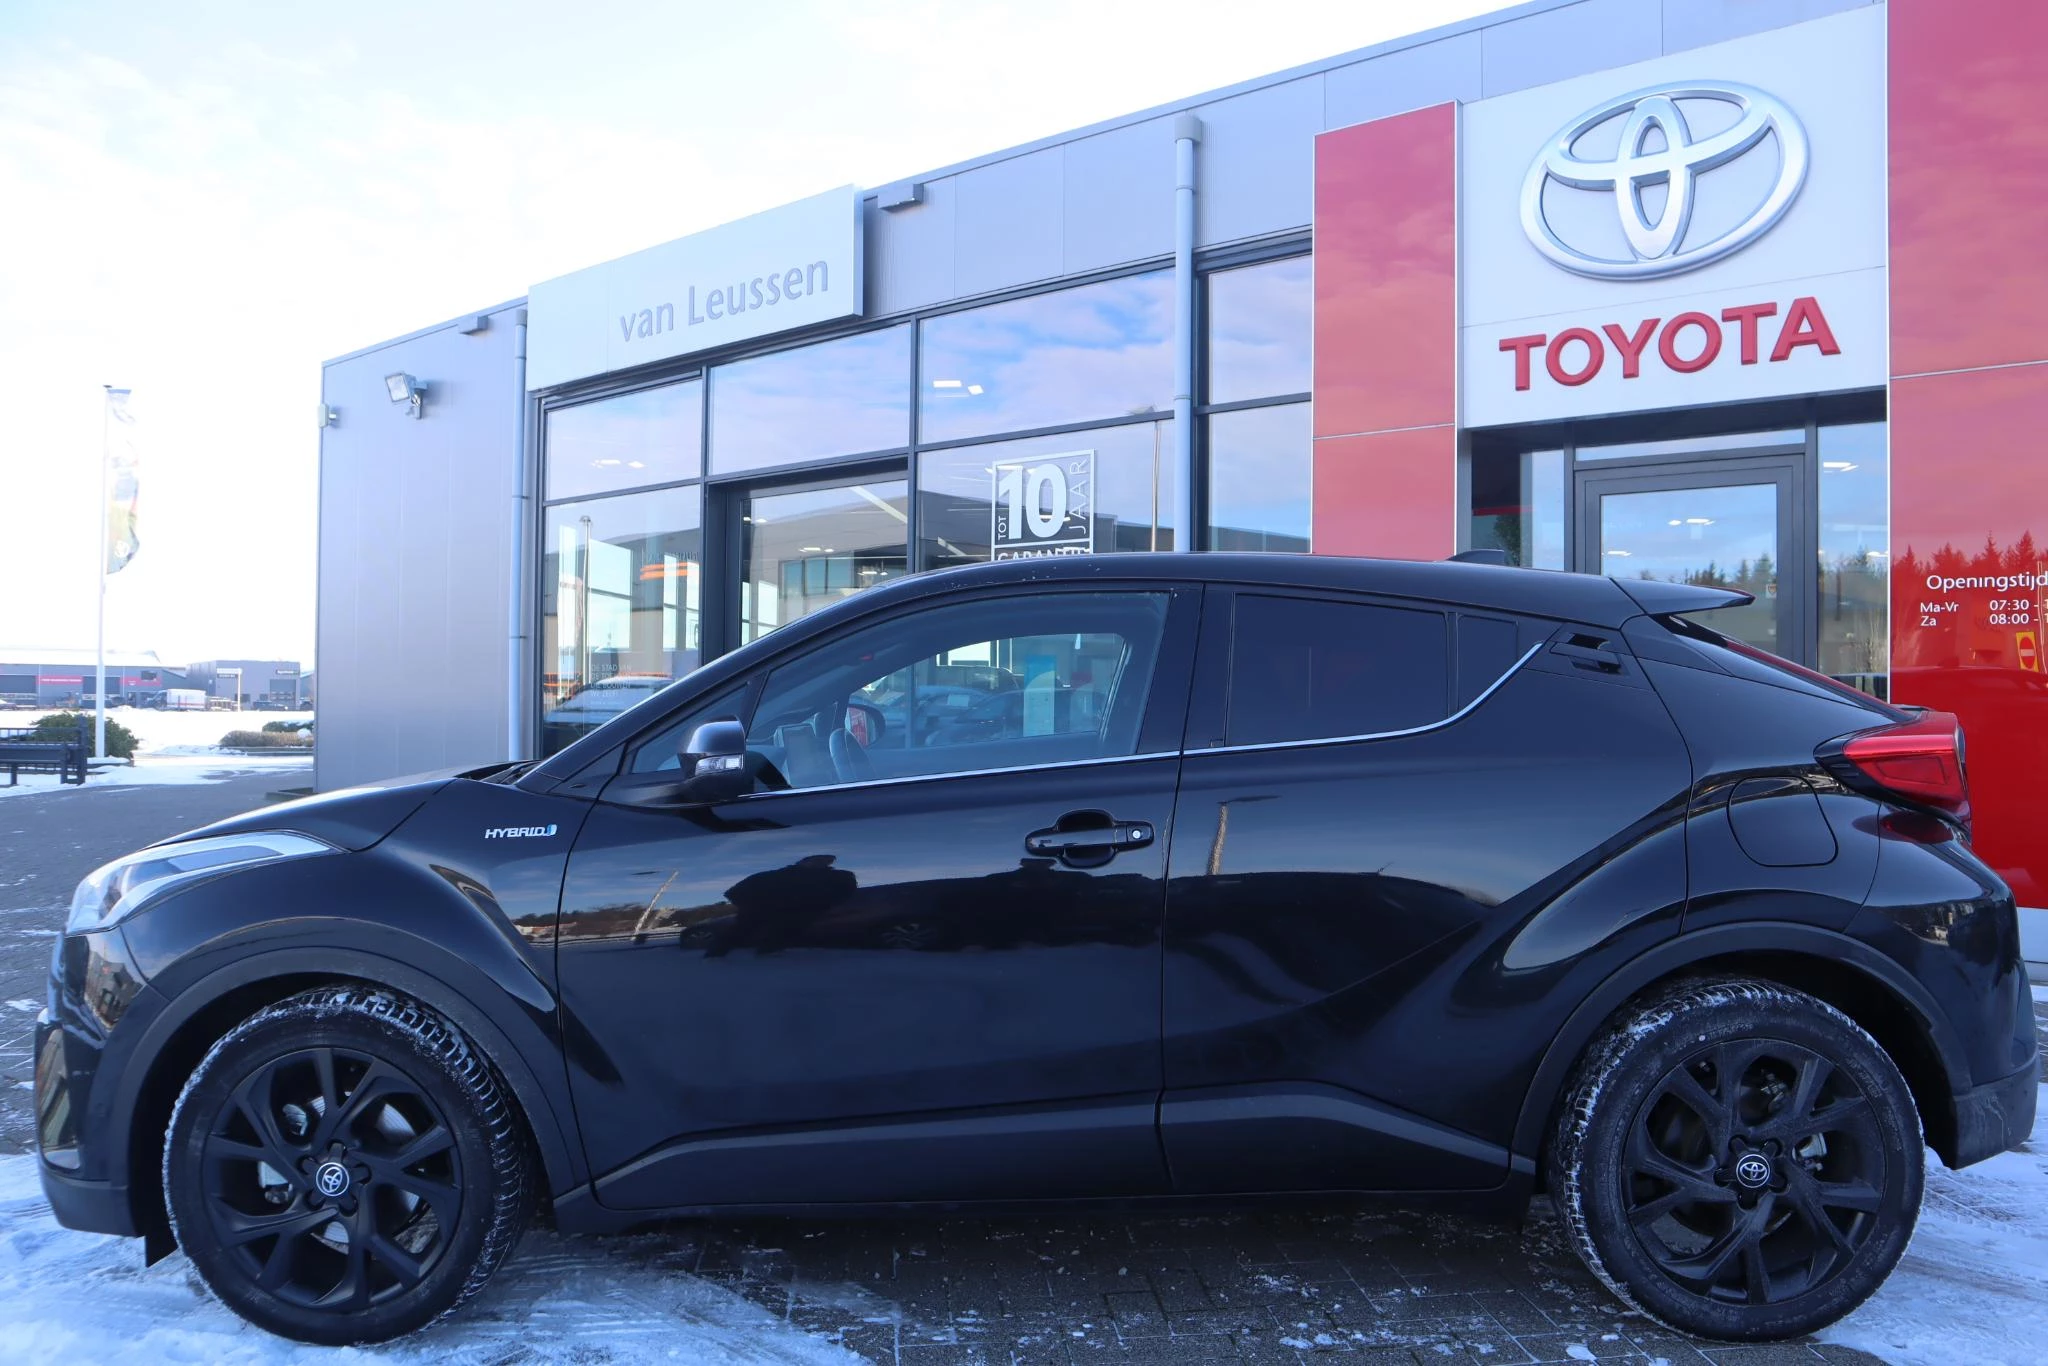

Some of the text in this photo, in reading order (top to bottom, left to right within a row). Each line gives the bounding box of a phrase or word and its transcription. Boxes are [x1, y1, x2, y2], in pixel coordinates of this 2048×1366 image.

[619, 260, 829, 343] van Leussen
[1498, 296, 1842, 392] TOYOTA
[998, 458, 1088, 541] TOT 10 JAAR
[1920, 601, 1960, 613] Ma-Vr
[1989, 599, 2030, 611] 07:30
[1920, 615, 1937, 627] Za
[1989, 613, 2030, 625] 08:00
[485, 826, 546, 839] HYBRID
